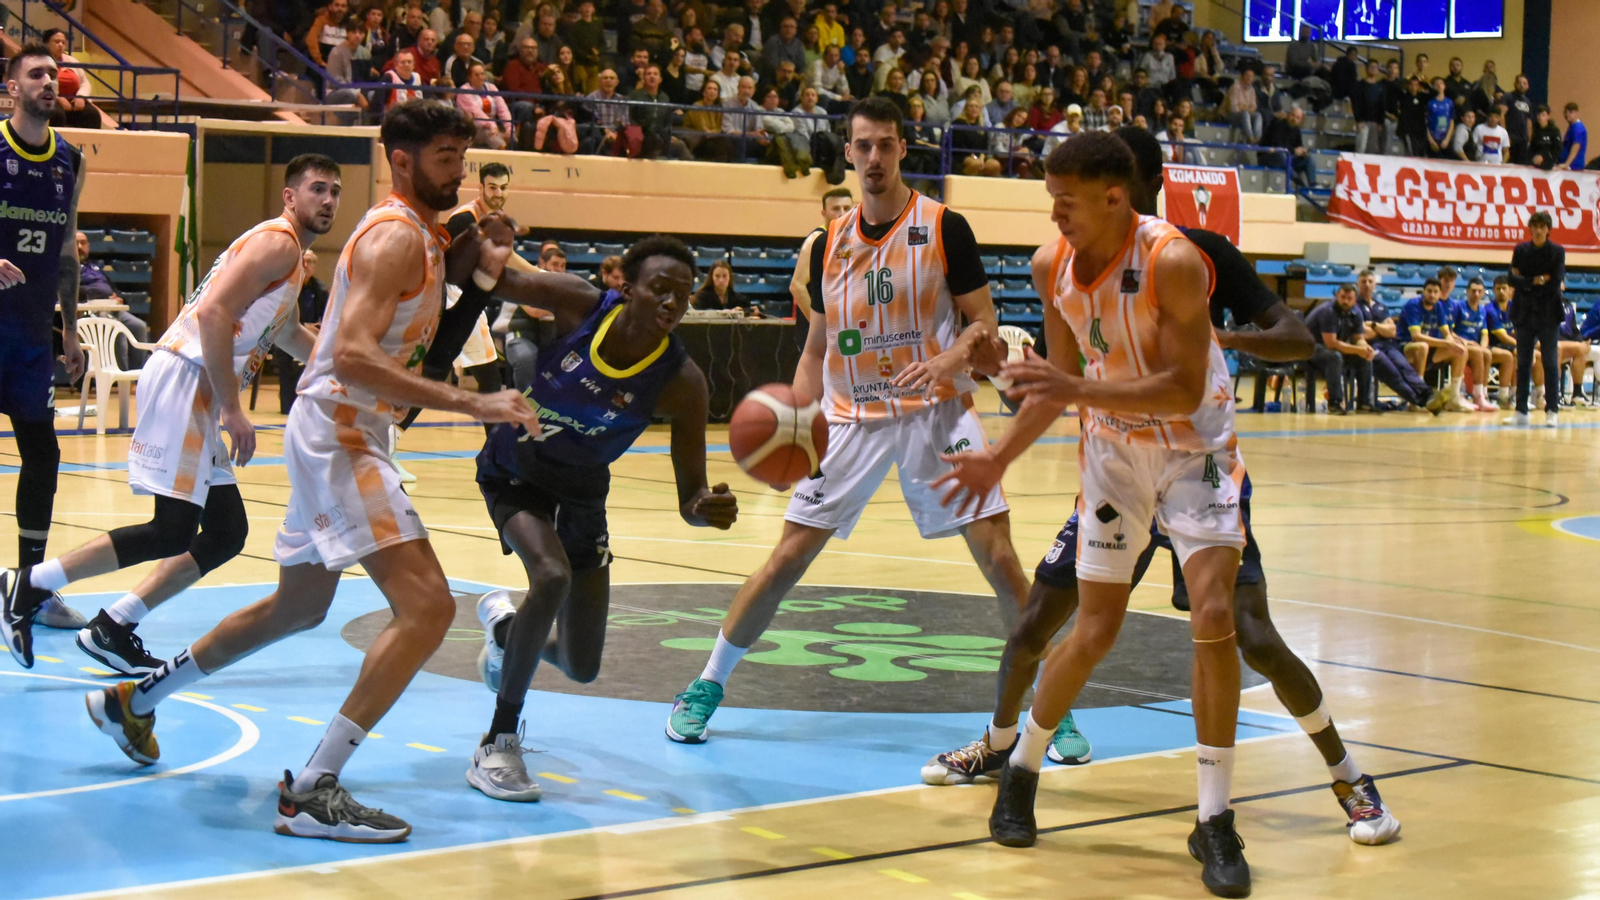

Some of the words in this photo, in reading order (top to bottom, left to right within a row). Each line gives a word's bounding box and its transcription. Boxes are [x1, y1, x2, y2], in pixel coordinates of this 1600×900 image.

[1168, 169, 1226, 186] KOMANDO
[1336, 157, 1582, 230] ALGECIRAS
[17, 229, 46, 254] 23
[1402, 222, 1437, 236] GRADA
[1467, 226, 1500, 239] FONDO
[864, 267, 894, 306] 16
[1089, 318, 1109, 354] 4
[1202, 454, 1221, 488] 4
[1088, 540, 1127, 550] RETAMARES
